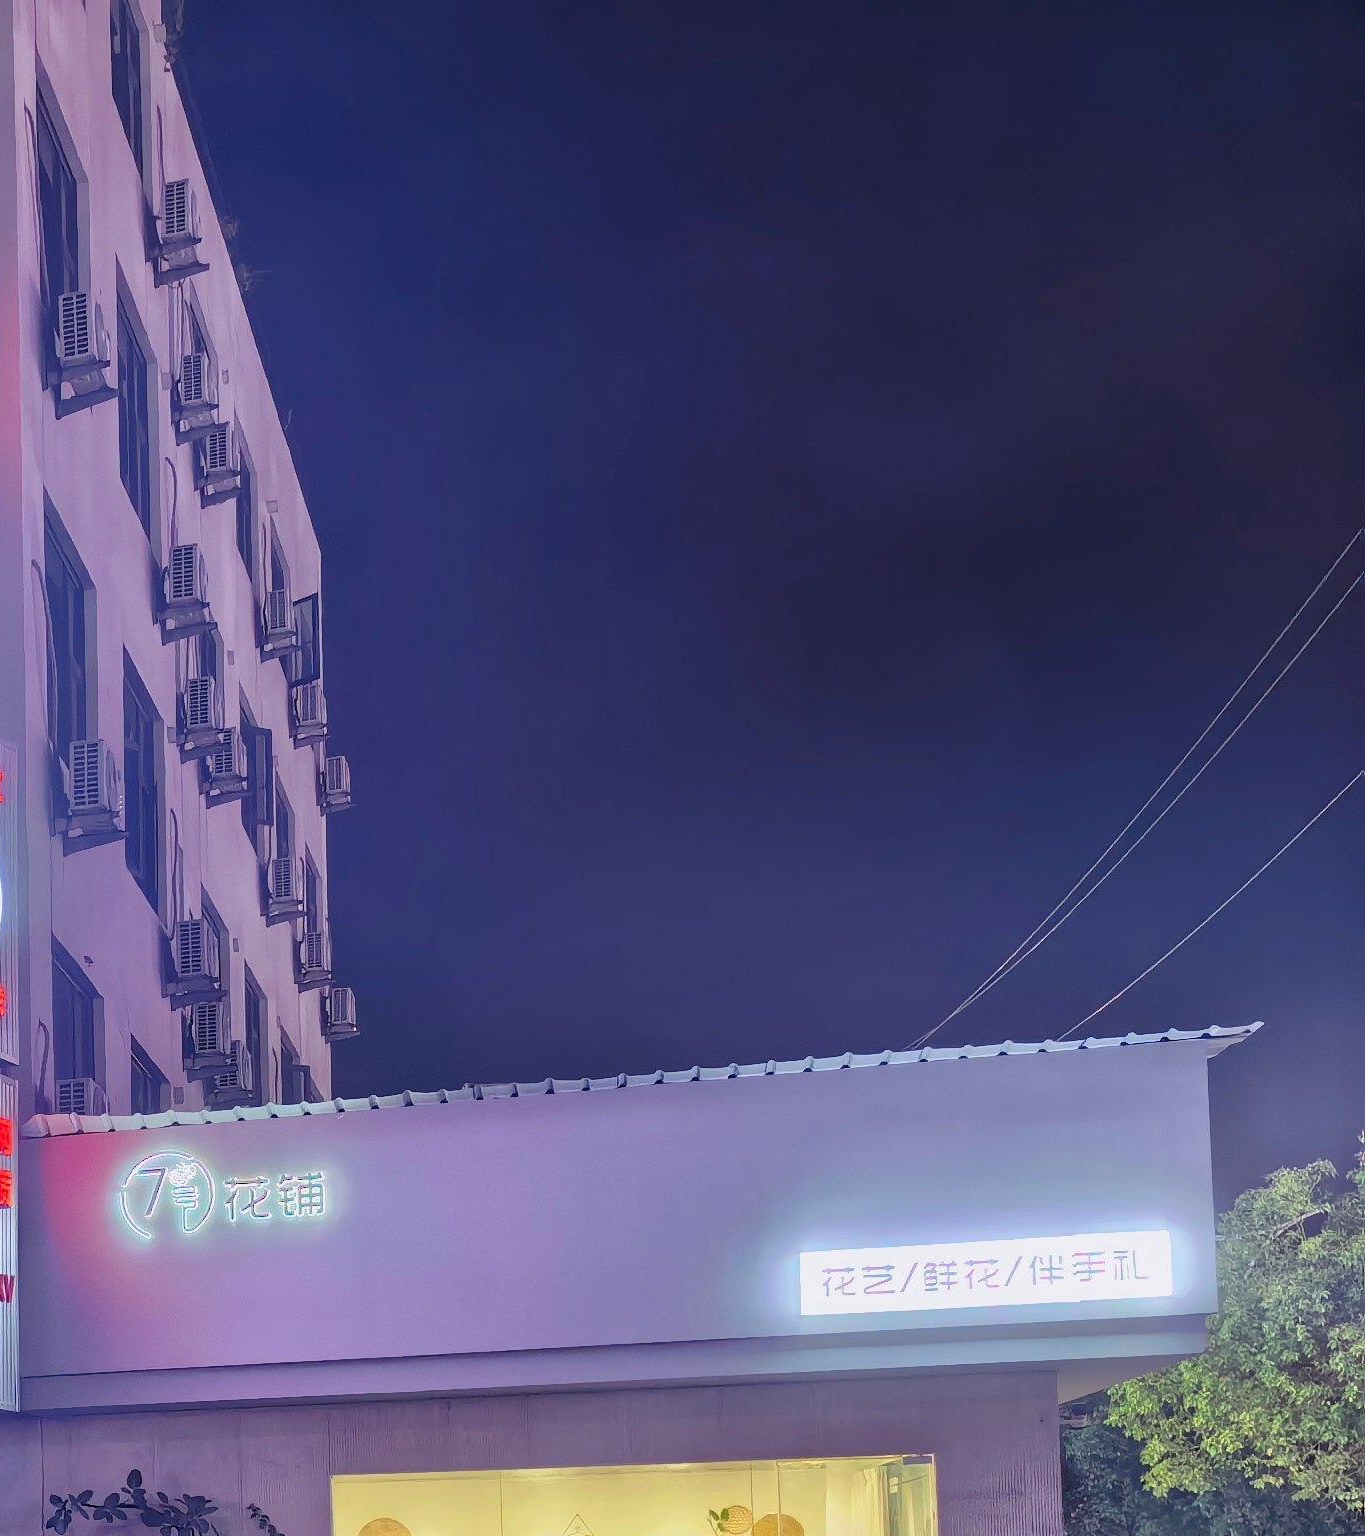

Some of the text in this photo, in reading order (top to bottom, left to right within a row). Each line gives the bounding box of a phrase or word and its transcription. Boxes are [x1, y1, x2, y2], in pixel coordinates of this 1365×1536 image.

[223, 1171, 327, 1222] 花铺
[821, 1250, 1149, 1297] 花艺/鲜花/伴手礼
